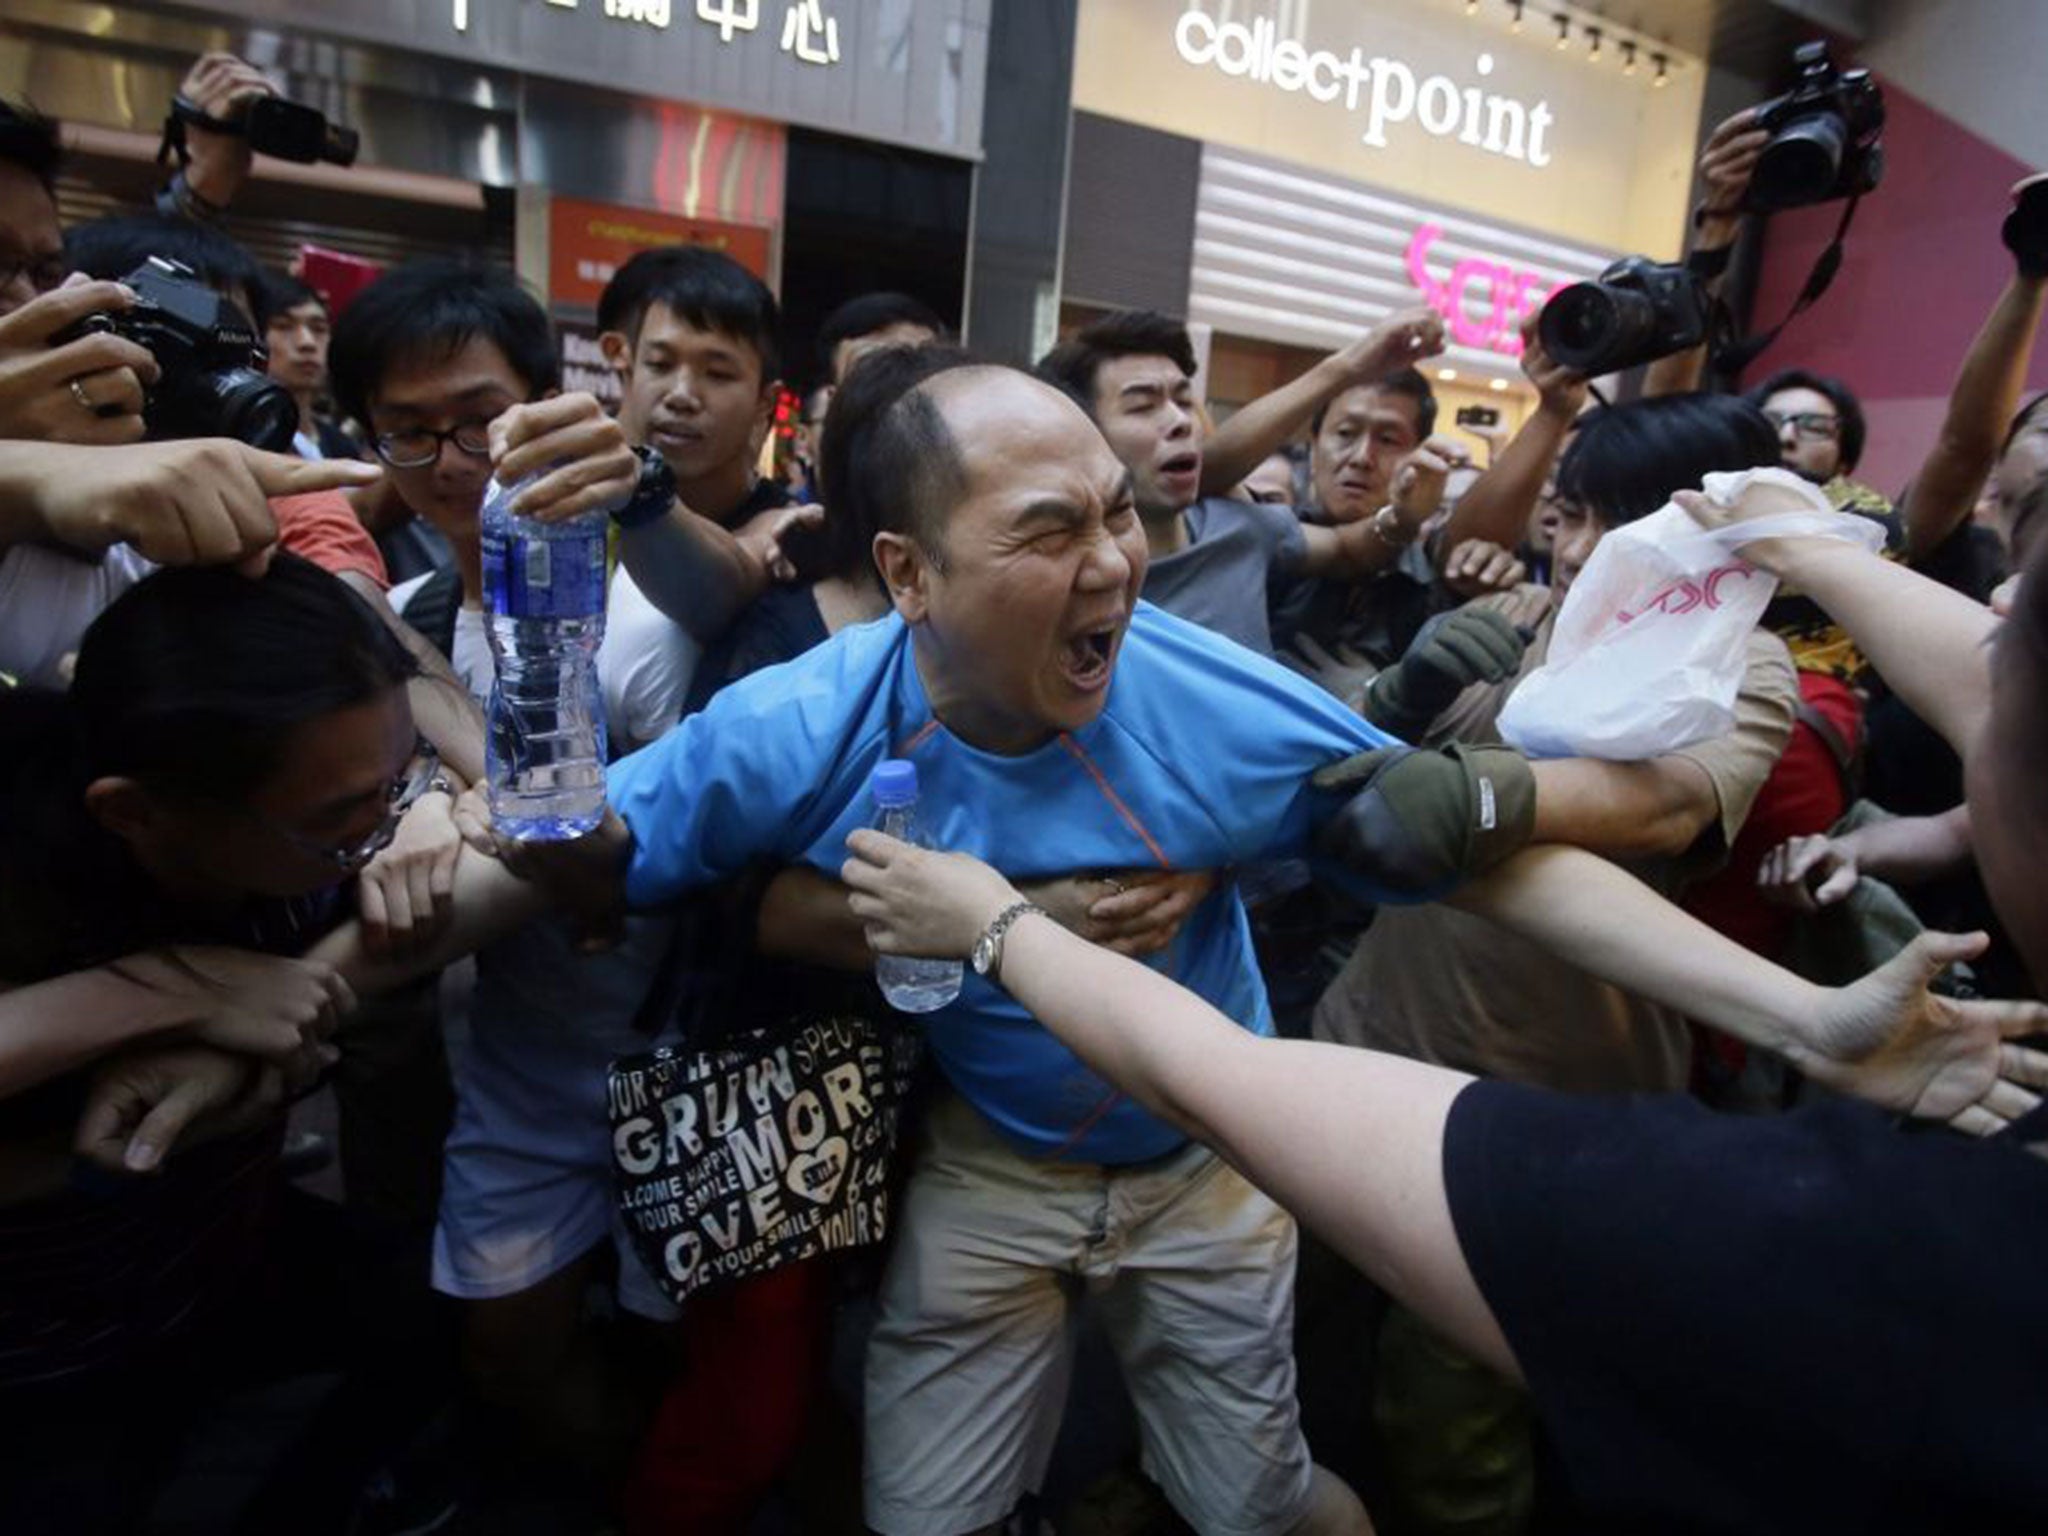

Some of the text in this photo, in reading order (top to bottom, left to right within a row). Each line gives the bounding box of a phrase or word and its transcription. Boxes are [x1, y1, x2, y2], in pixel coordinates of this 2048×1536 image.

[217, 331, 251, 343] Nikon
[635, 1168, 741, 1232] YOUR SMILE
[713, 1244, 765, 1275] YOUR
[767, 1208, 822, 1246] SMILE
